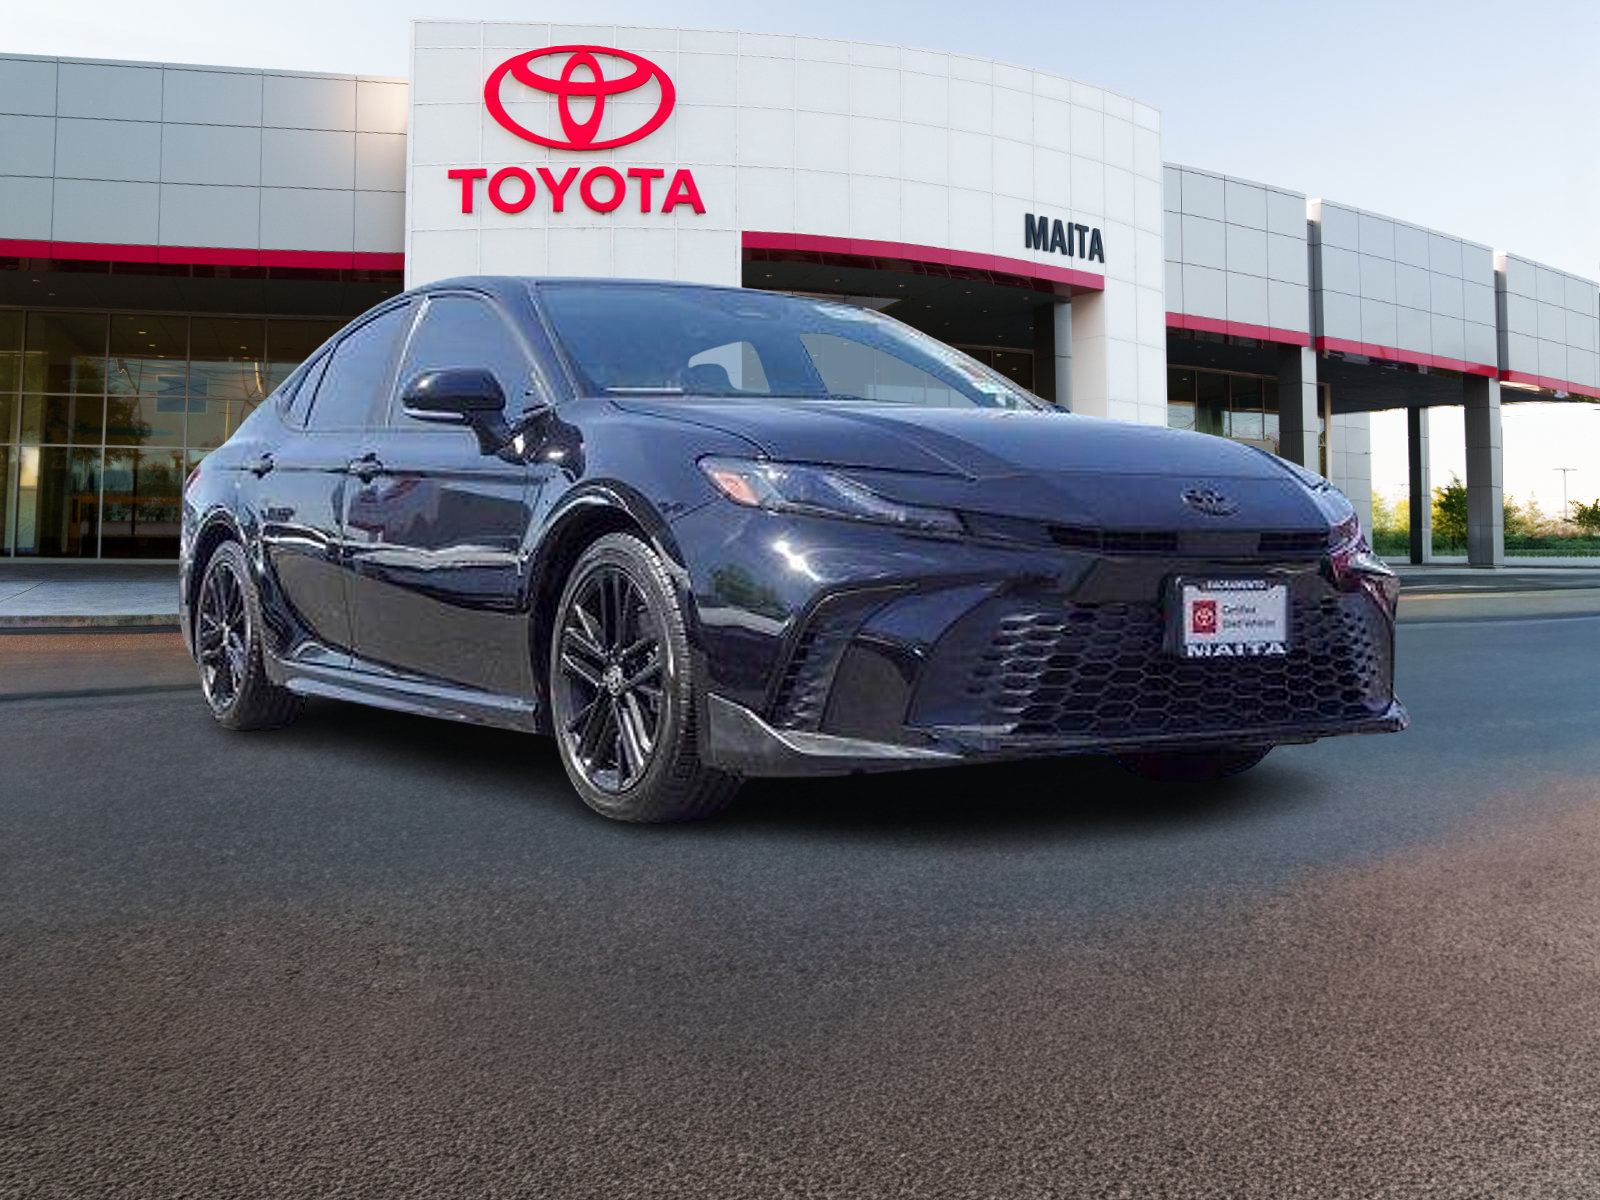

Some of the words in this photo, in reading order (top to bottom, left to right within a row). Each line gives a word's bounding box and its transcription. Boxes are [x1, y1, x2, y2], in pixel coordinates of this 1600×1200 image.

[448, 166, 706, 214] TOYOTA
[1025, 213, 1105, 263] MAITA
[1187, 643, 1286, 657] MAITA
